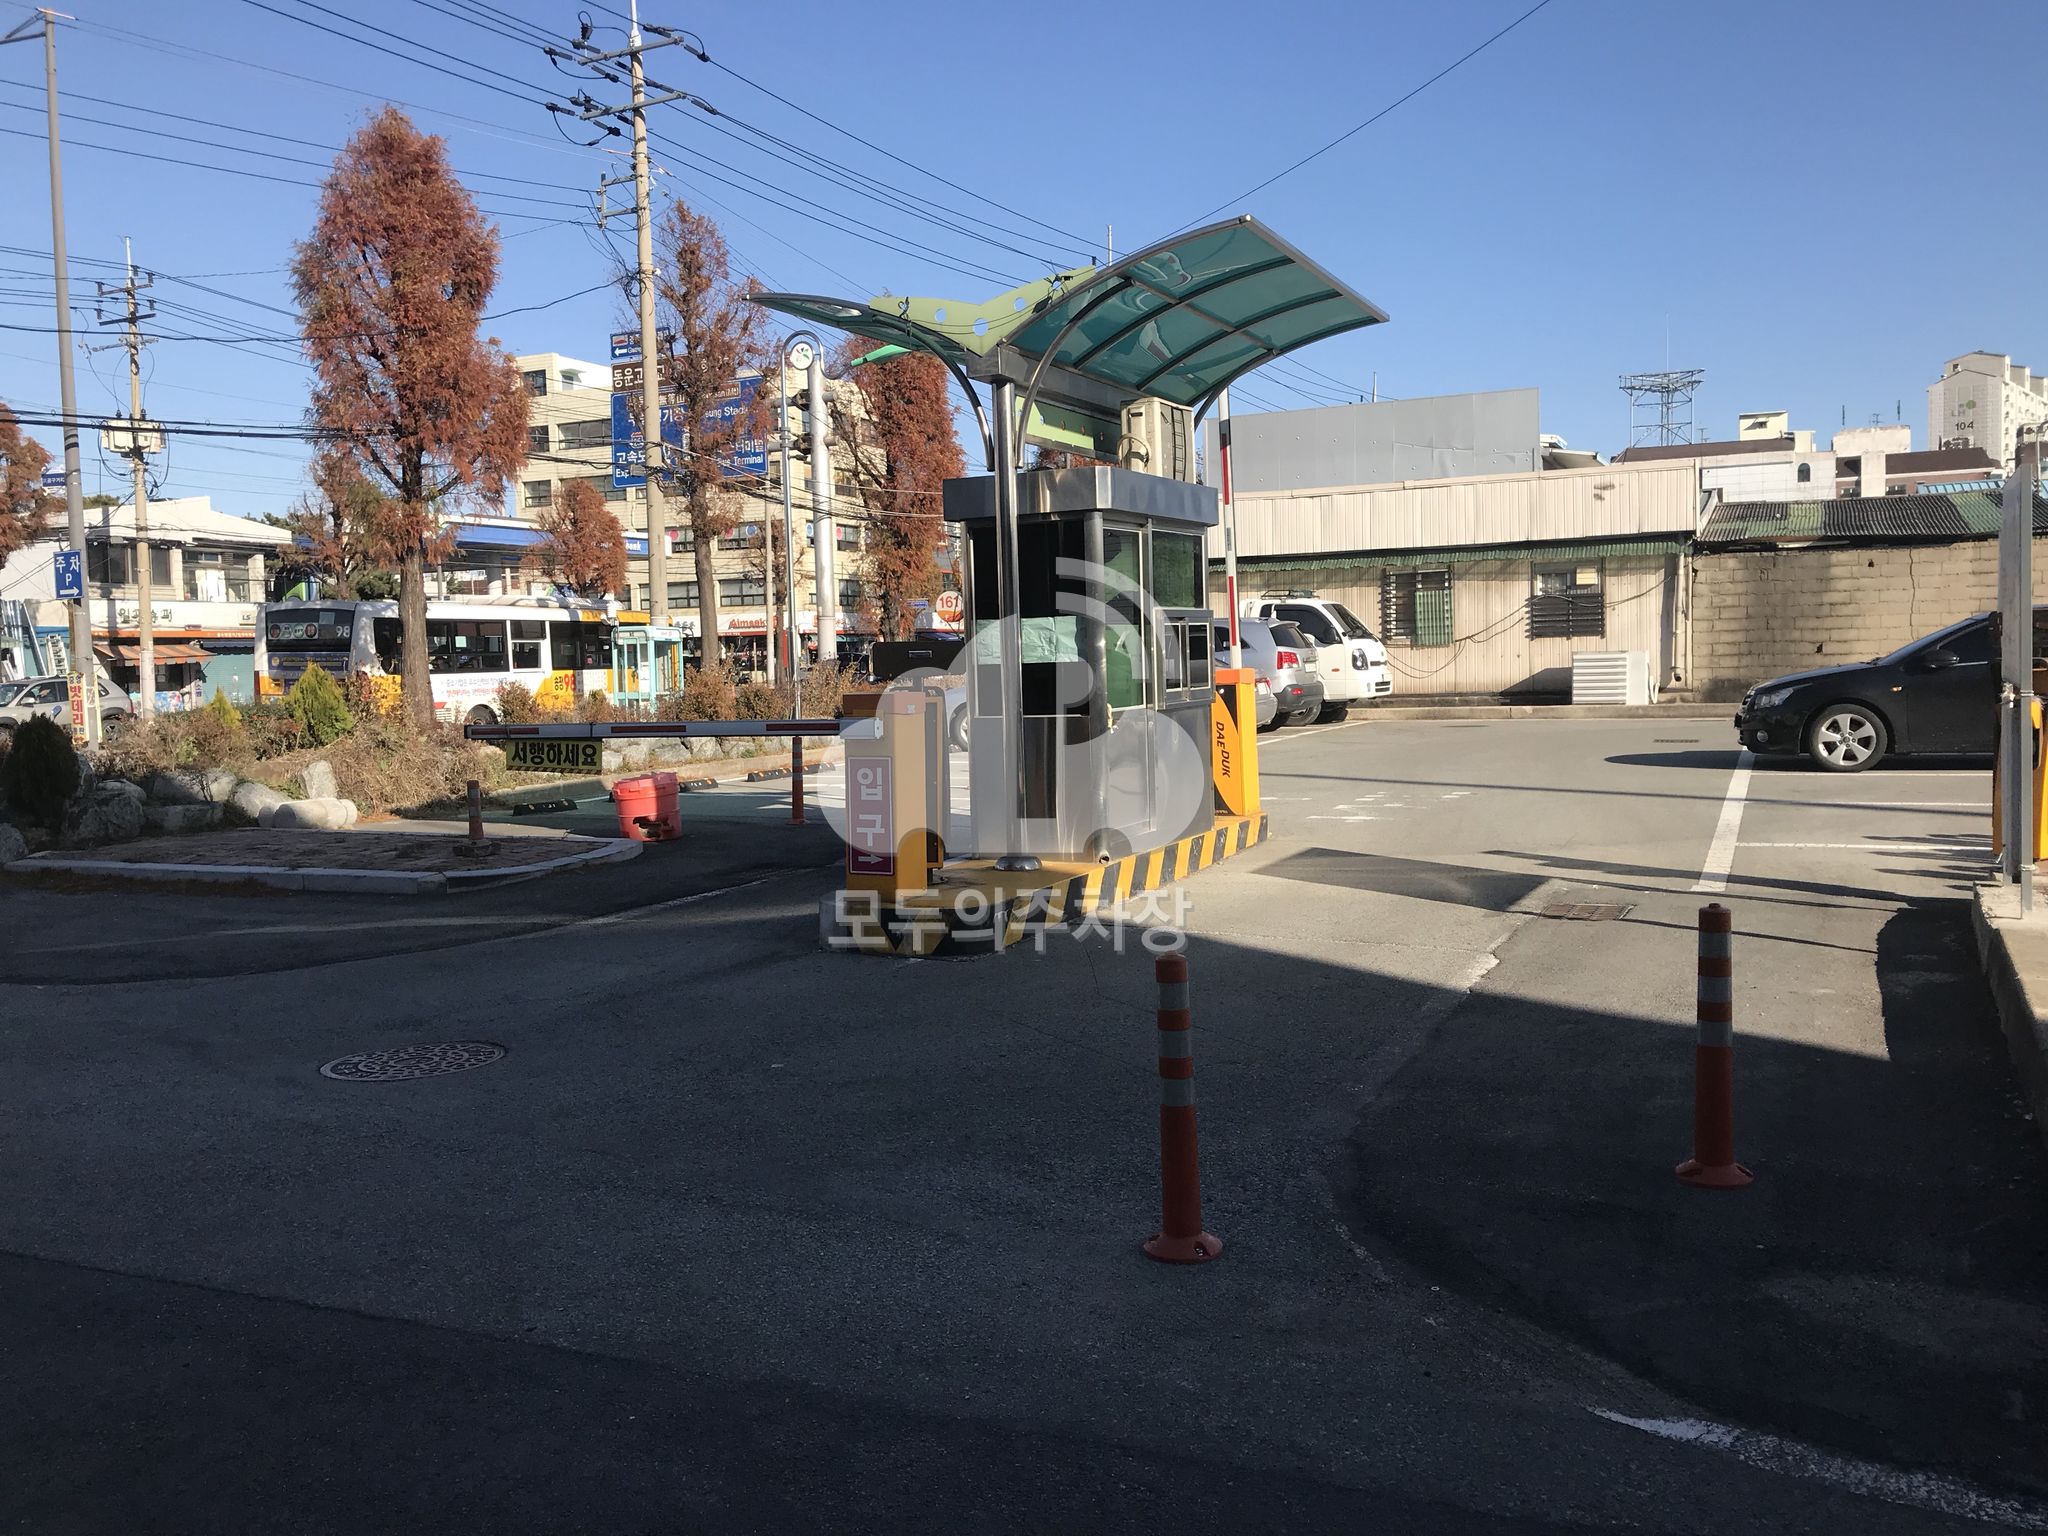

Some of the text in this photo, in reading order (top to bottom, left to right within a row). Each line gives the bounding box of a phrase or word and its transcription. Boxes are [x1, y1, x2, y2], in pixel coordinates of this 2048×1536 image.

[613, 364, 666, 388] 동운고교
[1955, 421, 1974, 430] 104
[734, 454, 764, 466] Terminal
[65, 573, 72, 586] P
[939, 595, 959, 609] 161
[335, 625, 351, 638] 98
[564, 673, 576, 692] 98
[511, 741, 597, 767] 서행하세요
[856, 767, 886, 847] 입구
